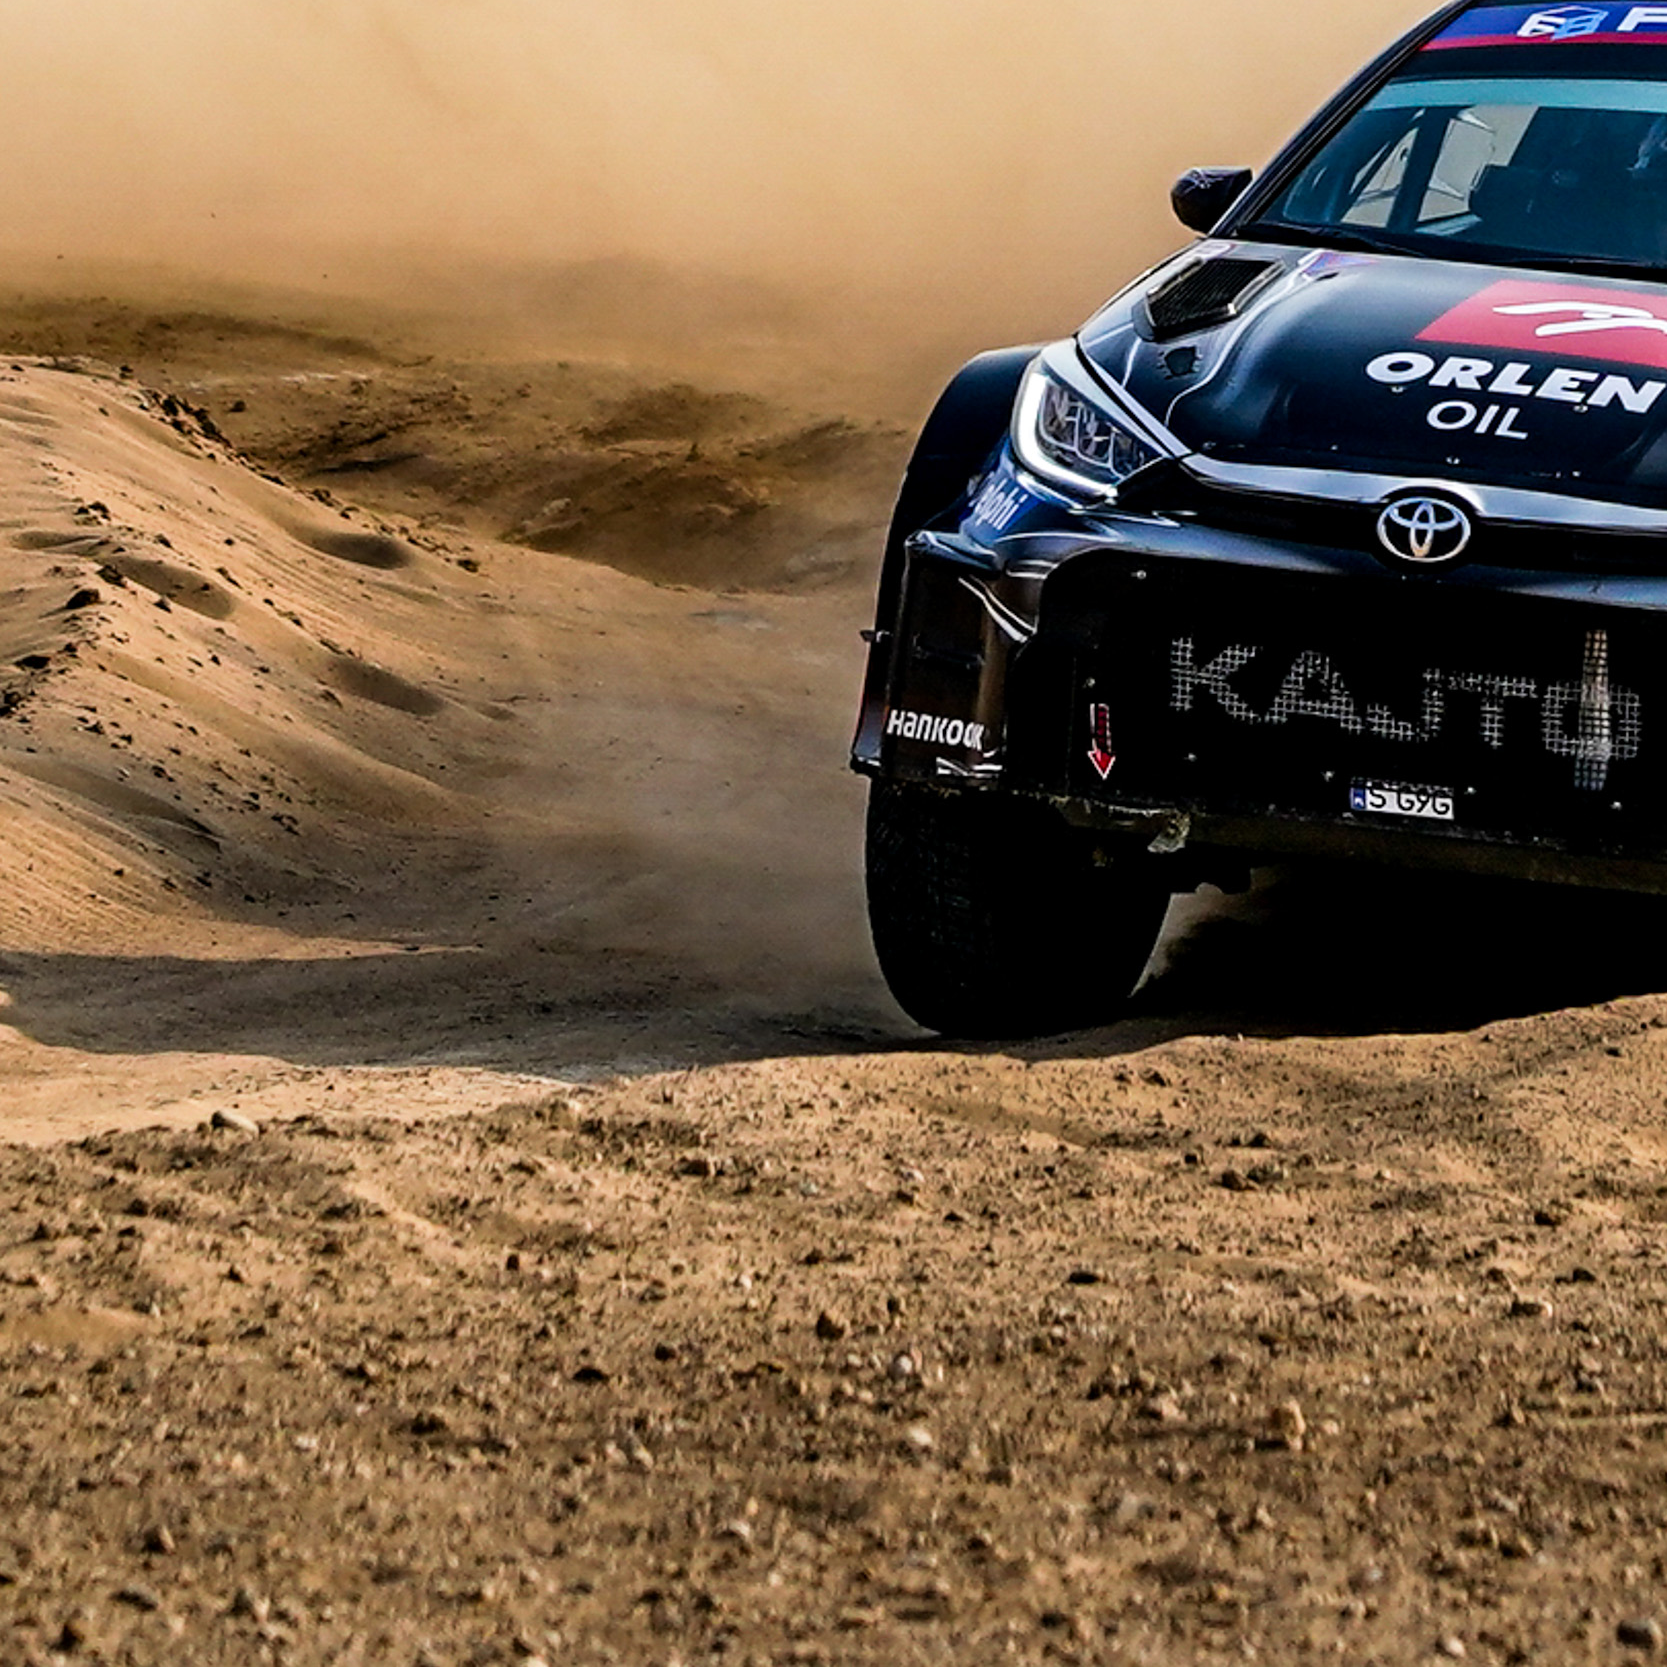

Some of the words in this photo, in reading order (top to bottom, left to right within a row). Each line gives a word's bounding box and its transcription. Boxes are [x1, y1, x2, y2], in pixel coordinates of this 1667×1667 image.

[1366, 351, 1667, 413] ORLEN
[1426, 400, 1529, 439] OIL
[1170, 636, 1642, 759] KAJTO
